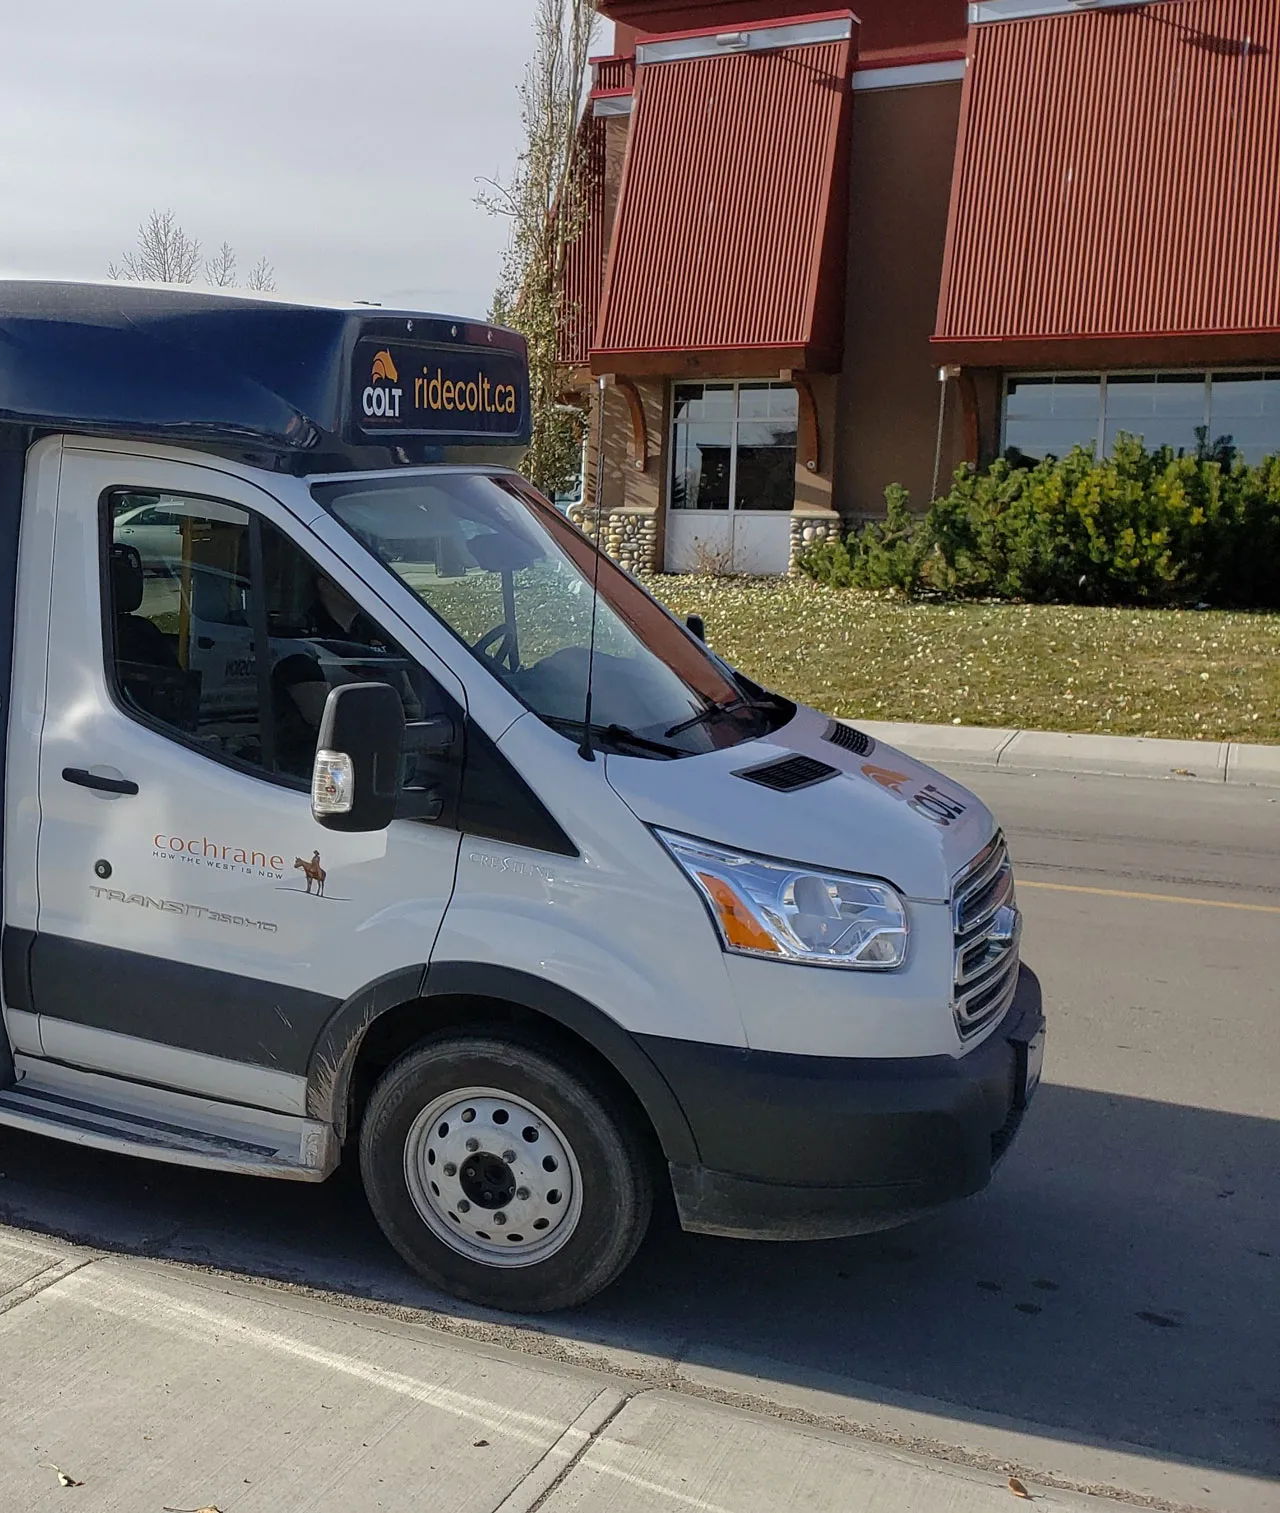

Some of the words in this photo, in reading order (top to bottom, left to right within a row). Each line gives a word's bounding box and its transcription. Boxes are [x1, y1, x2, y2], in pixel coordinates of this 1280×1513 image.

[362, 387, 402, 417] COLT
[414, 366, 515, 413] ridecolt.ca
[906, 784, 968, 826] COLT
[152, 850, 176, 860] HOW
[181, 855, 201, 865] THE
[206, 860, 236, 871] WEST
[241, 866, 252, 875] IS
[258, 870, 283, 880] NOW
[154, 834, 284, 871] cochrane
[89, 885, 209, 918] TRANSIT
